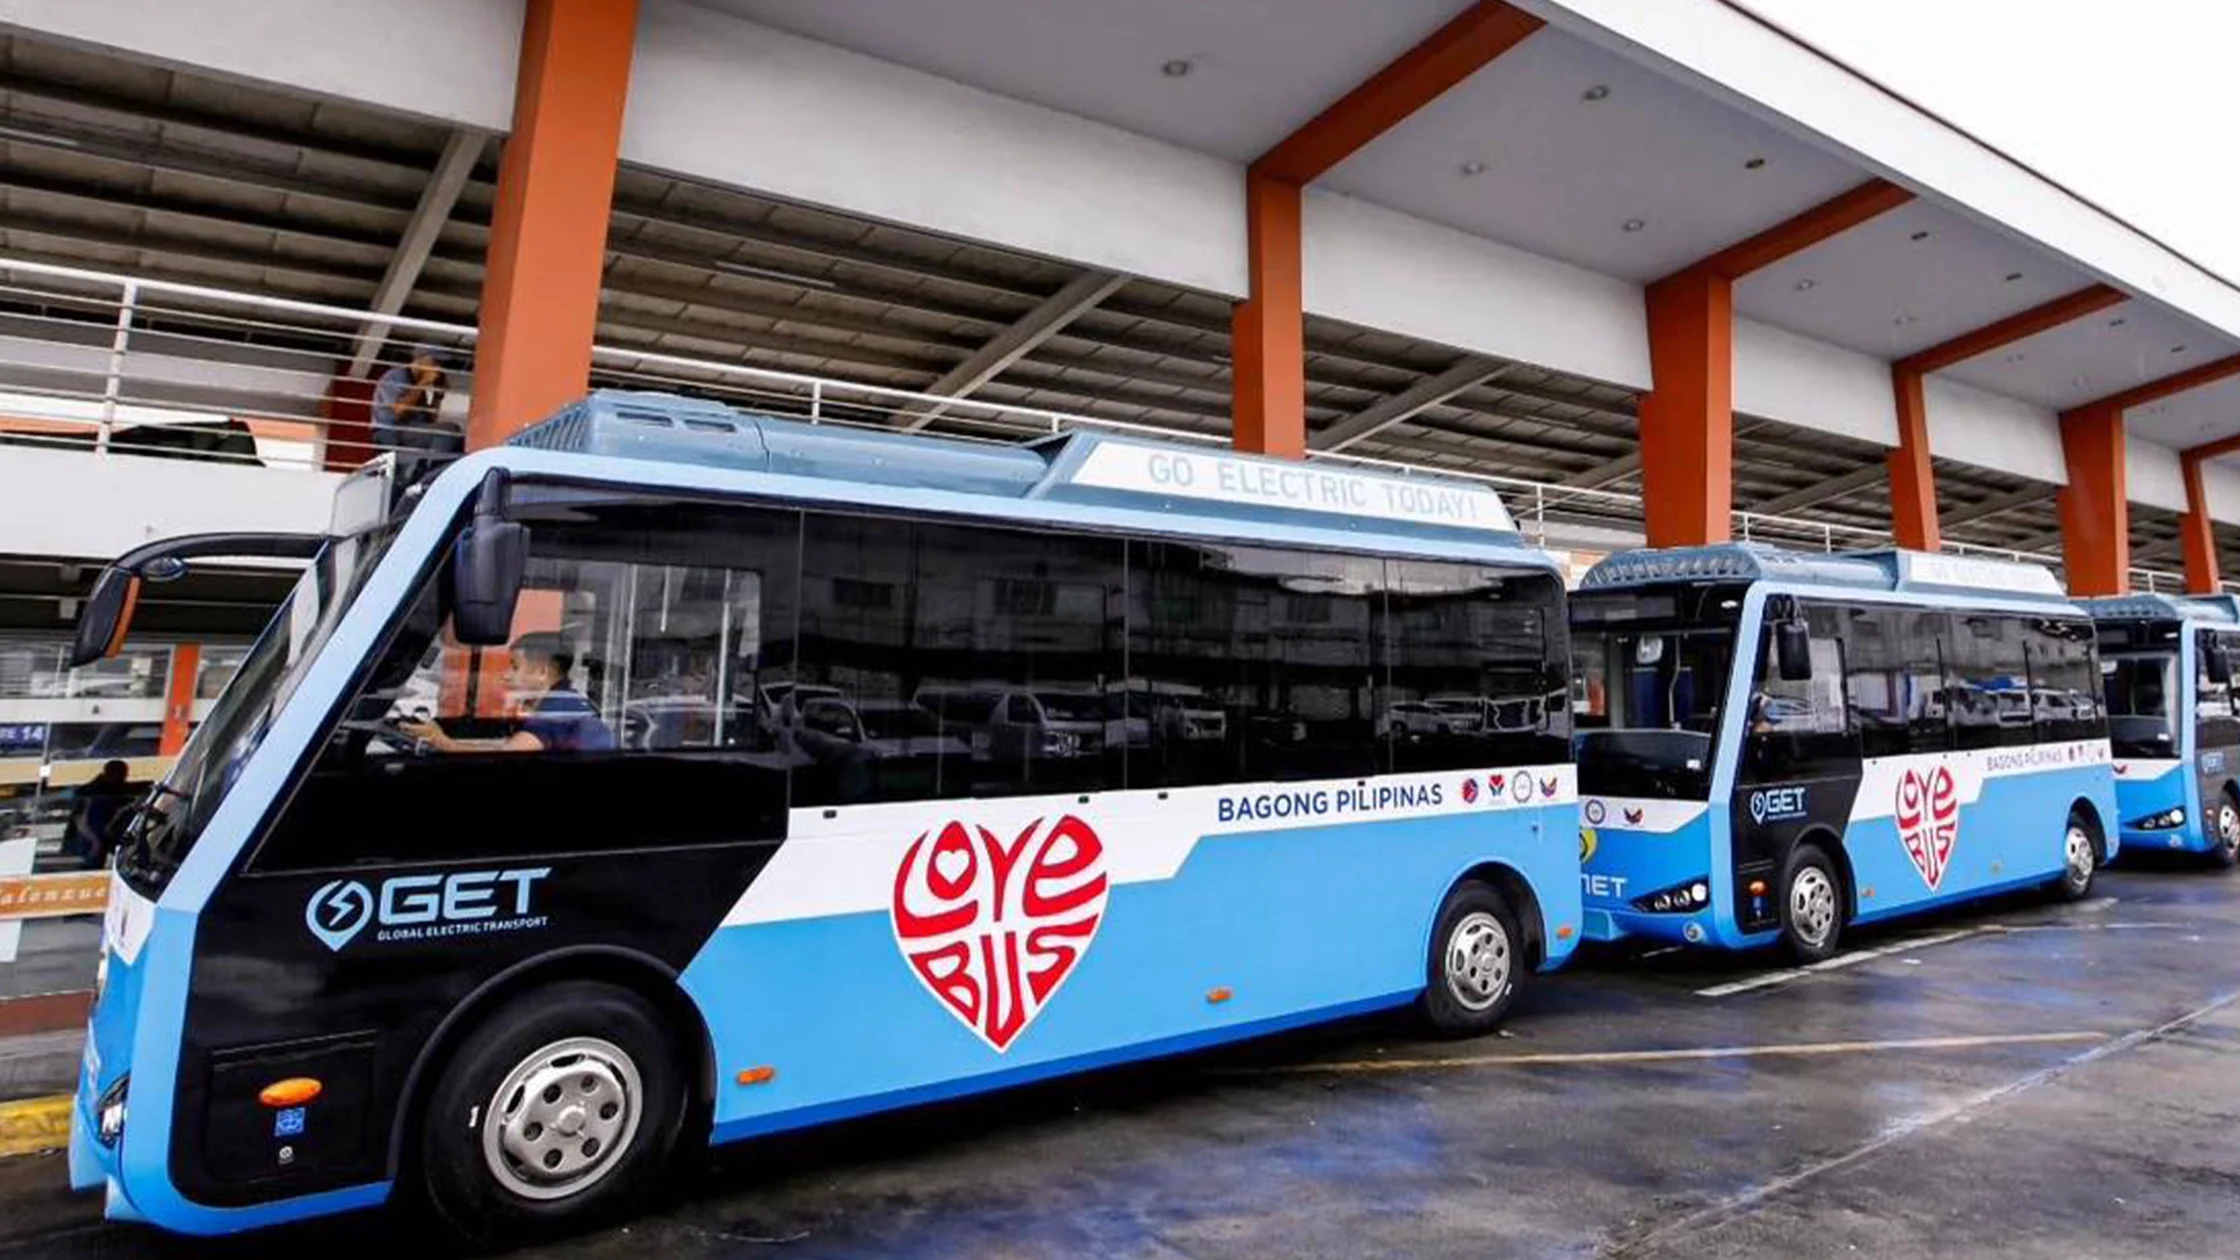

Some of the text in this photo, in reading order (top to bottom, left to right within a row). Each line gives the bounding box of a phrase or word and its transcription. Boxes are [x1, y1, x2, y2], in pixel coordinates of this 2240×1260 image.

[1148, 453, 1477, 520] GO ELECTRIC TODAY!
[1217, 782, 1443, 822] BAGONG PILIPINAS
[1766, 787, 1806, 813] GET
[1905, 820, 1956, 886] BUS
[379, 867, 553, 925] GET
[377, 917, 549, 941] GLOBAL ELECTRIC TRANSPORT
[909, 912, 1100, 1049] BUS
